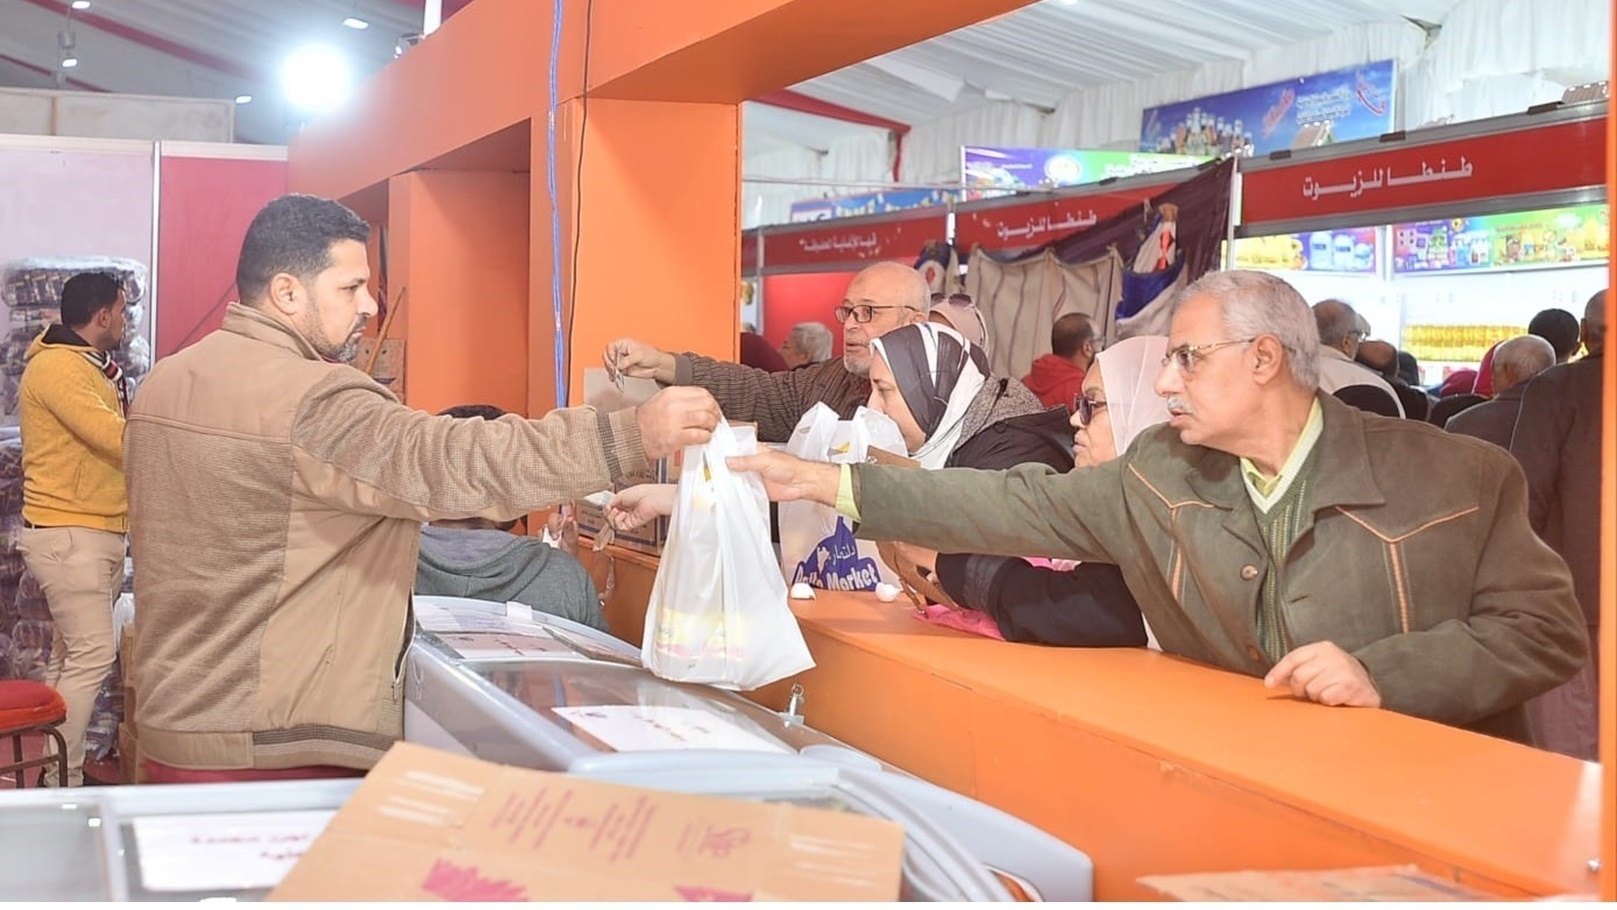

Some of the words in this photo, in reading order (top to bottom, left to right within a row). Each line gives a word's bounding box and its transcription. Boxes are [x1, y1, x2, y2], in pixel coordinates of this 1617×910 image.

[1302, 167, 1384, 201] للزيوت
[1387, 155, 1473, 186] طنطا
[997, 216, 1046, 241] للزيوت
[1047, 209, 1098, 231] طنطا
[826, 563, 879, 591] Market
